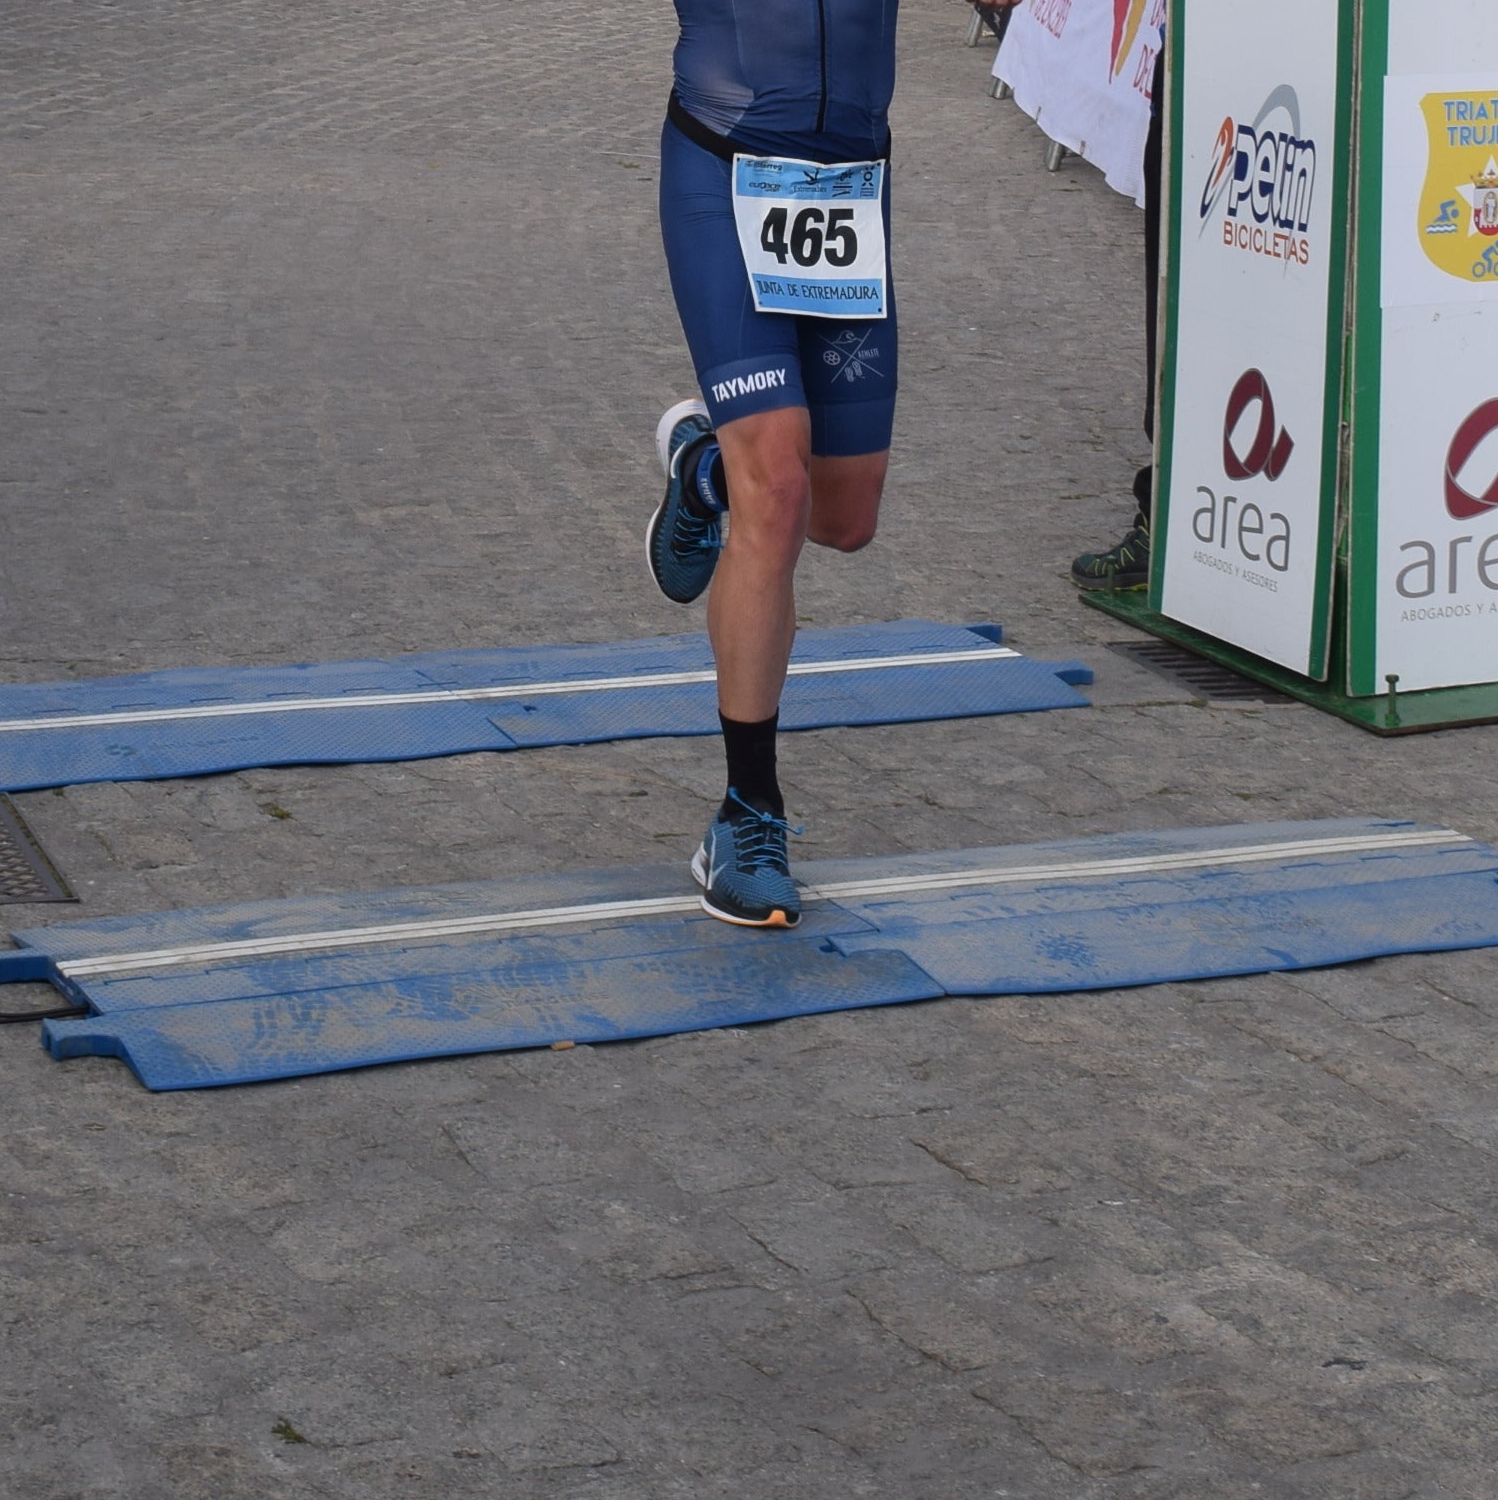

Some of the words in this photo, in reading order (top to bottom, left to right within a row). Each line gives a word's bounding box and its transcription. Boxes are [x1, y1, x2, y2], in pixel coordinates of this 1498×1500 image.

[760, 207, 858, 267] 465
[1223, 220, 1310, 265] BICICLETAS
[756, 280, 784, 296] JUNTA
[788, 282, 800, 297] DE
[802, 284, 879, 300] EXTREMADURA
[711, 368, 787, 403] TAYMORY
[1192, 485, 1291, 572] area
[1401, 603, 1472, 622] ABOGADOS
[1475, 601, 1484, 614] Y
